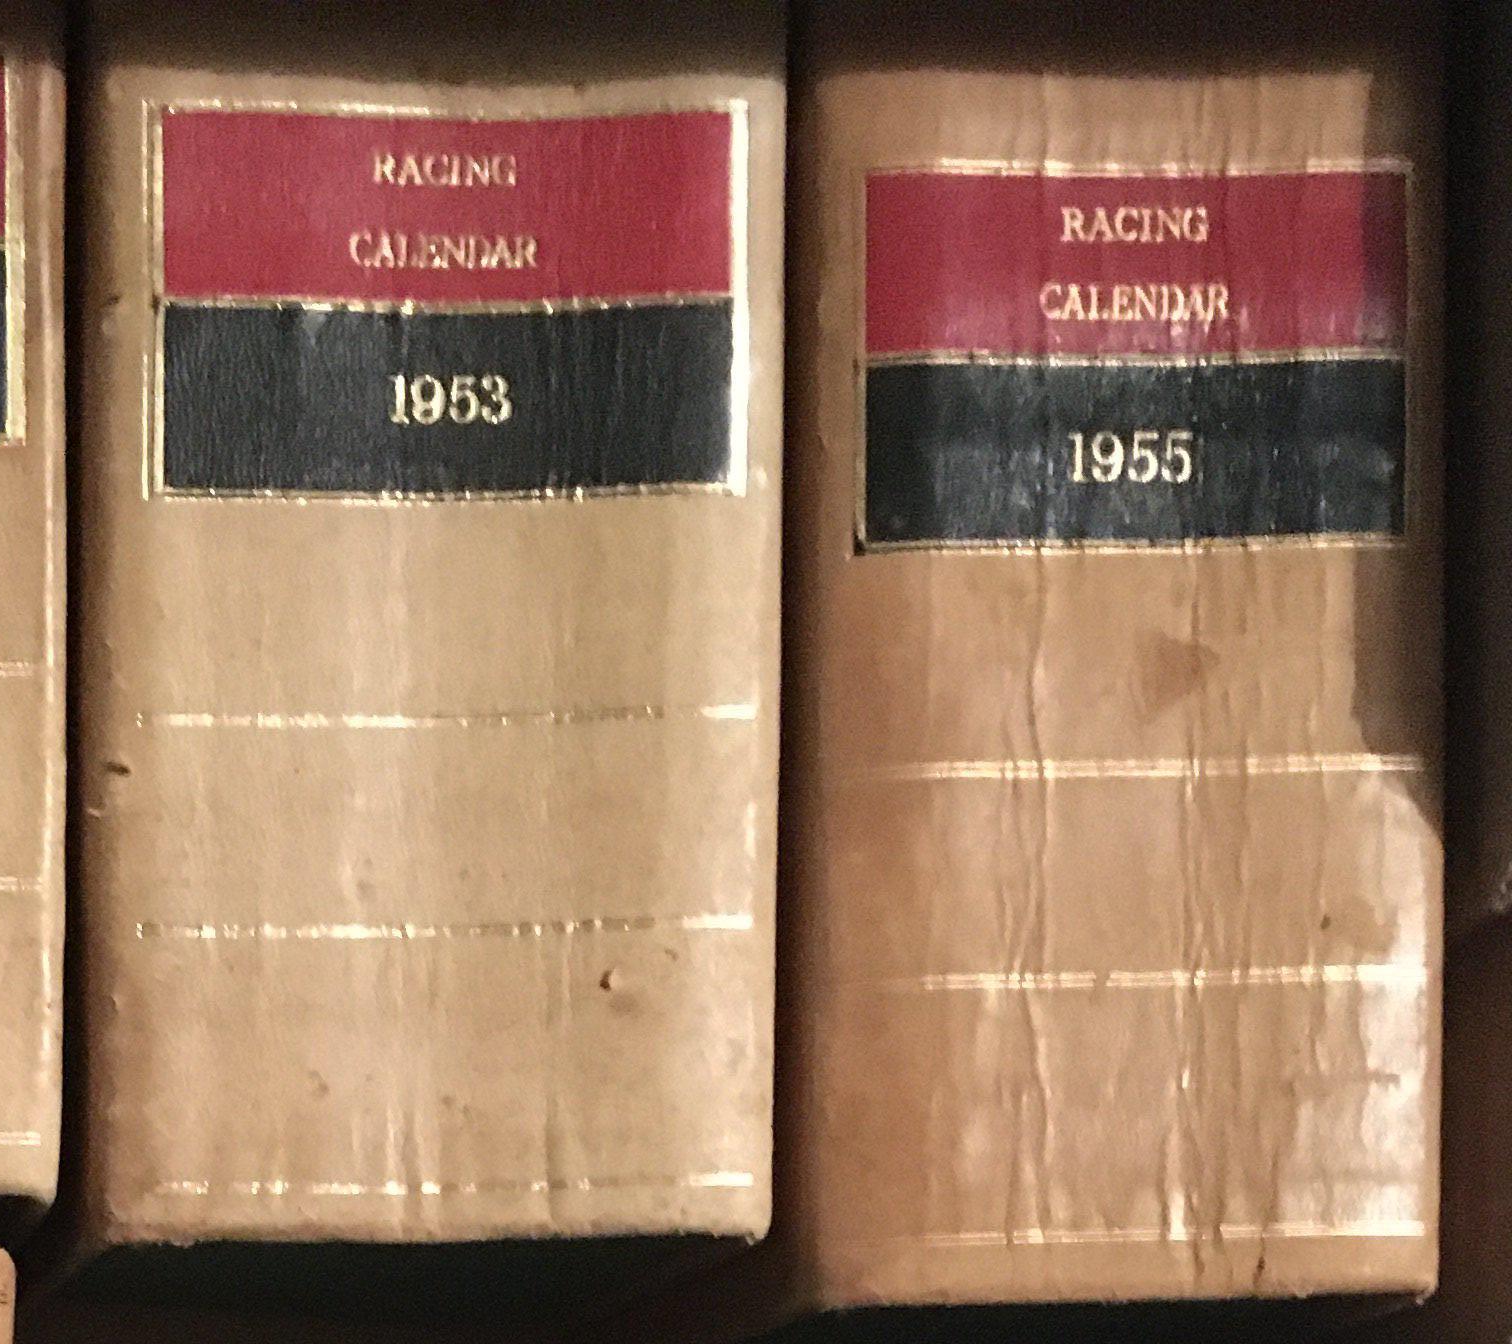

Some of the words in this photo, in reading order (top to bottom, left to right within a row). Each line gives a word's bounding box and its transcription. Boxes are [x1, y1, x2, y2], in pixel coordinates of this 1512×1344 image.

[372, 153, 517, 189] RACING
[1060, 207, 1210, 243] RACING
[348, 231, 540, 272] CALENDAR
[1039, 283, 1230, 324] CALENDAR
[389, 376, 513, 426] 1953
[1065, 433, 1196, 483] 1955
